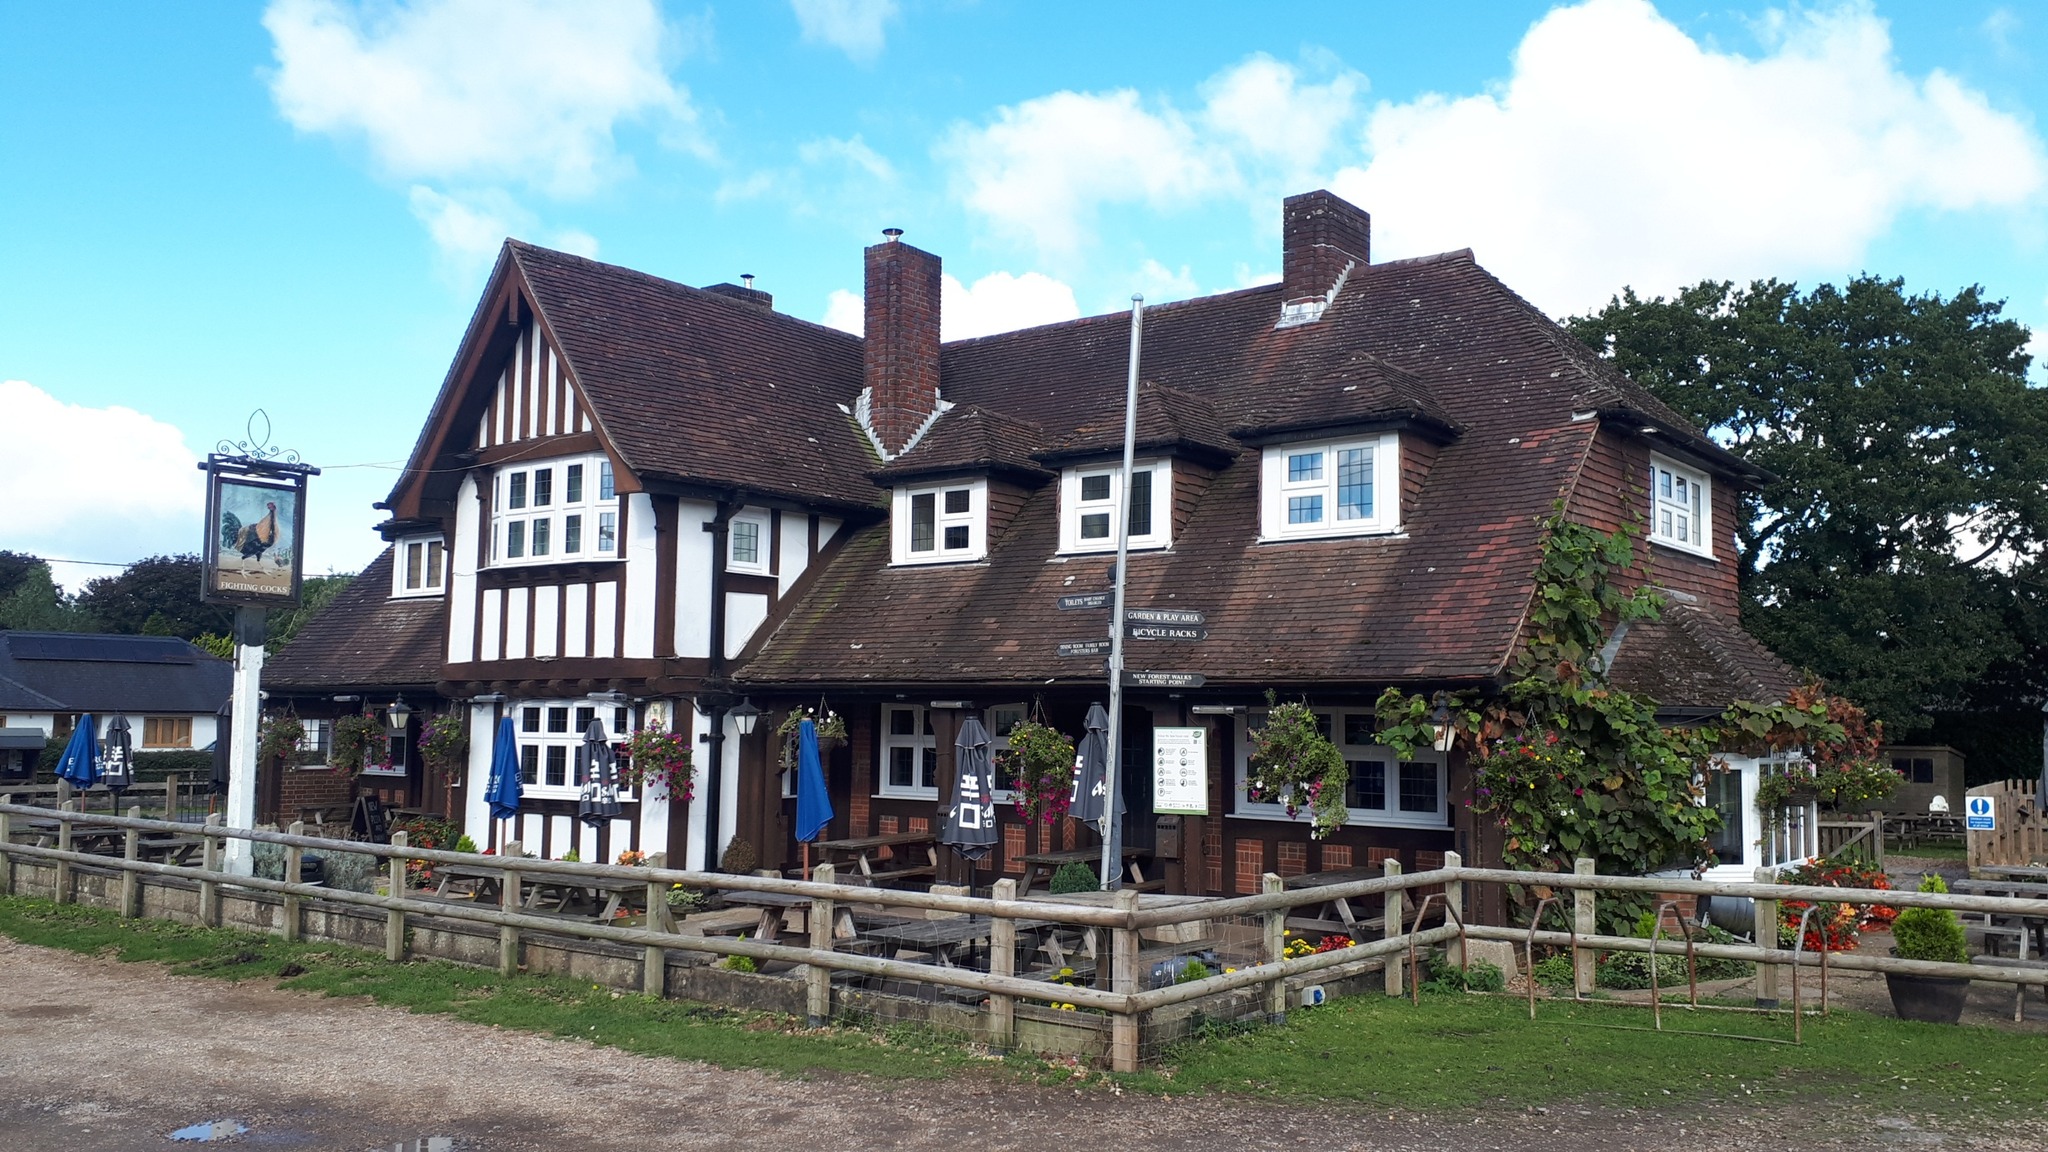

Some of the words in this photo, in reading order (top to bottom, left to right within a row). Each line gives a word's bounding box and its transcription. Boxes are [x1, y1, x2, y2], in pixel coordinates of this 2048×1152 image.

[220, 581, 258, 591] FIGHTING
[260, 584, 288, 593] COCKS
[1065, 598, 1084, 606] TOILETS
[1128, 612, 1154, 620] GARDEN
[1169, 630, 1197, 638] RACKS
